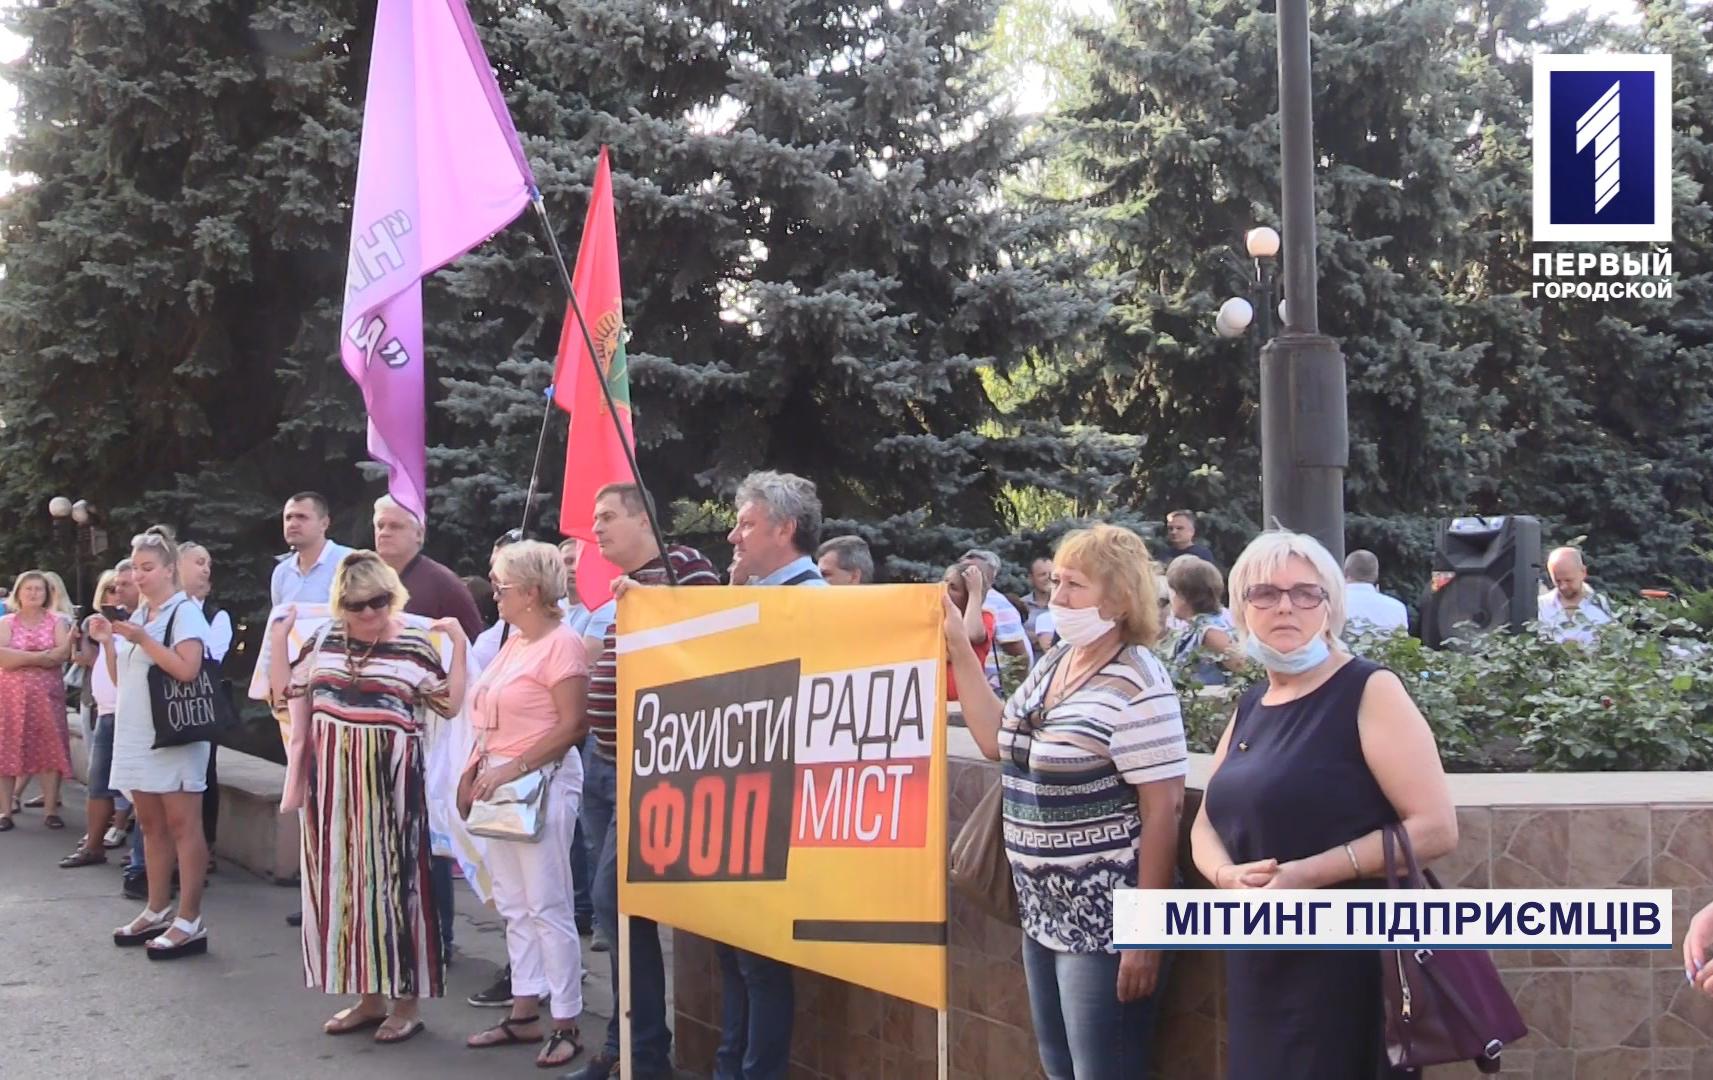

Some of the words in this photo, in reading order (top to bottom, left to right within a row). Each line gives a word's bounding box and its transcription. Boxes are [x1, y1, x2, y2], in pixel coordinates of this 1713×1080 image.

[168, 697, 215, 732] QUEEN
[634, 692, 793, 777] Захисти
[805, 667, 925, 761] РАДА
[638, 772, 773, 877] ФОП
[799, 764, 913, 841] МІСТ
